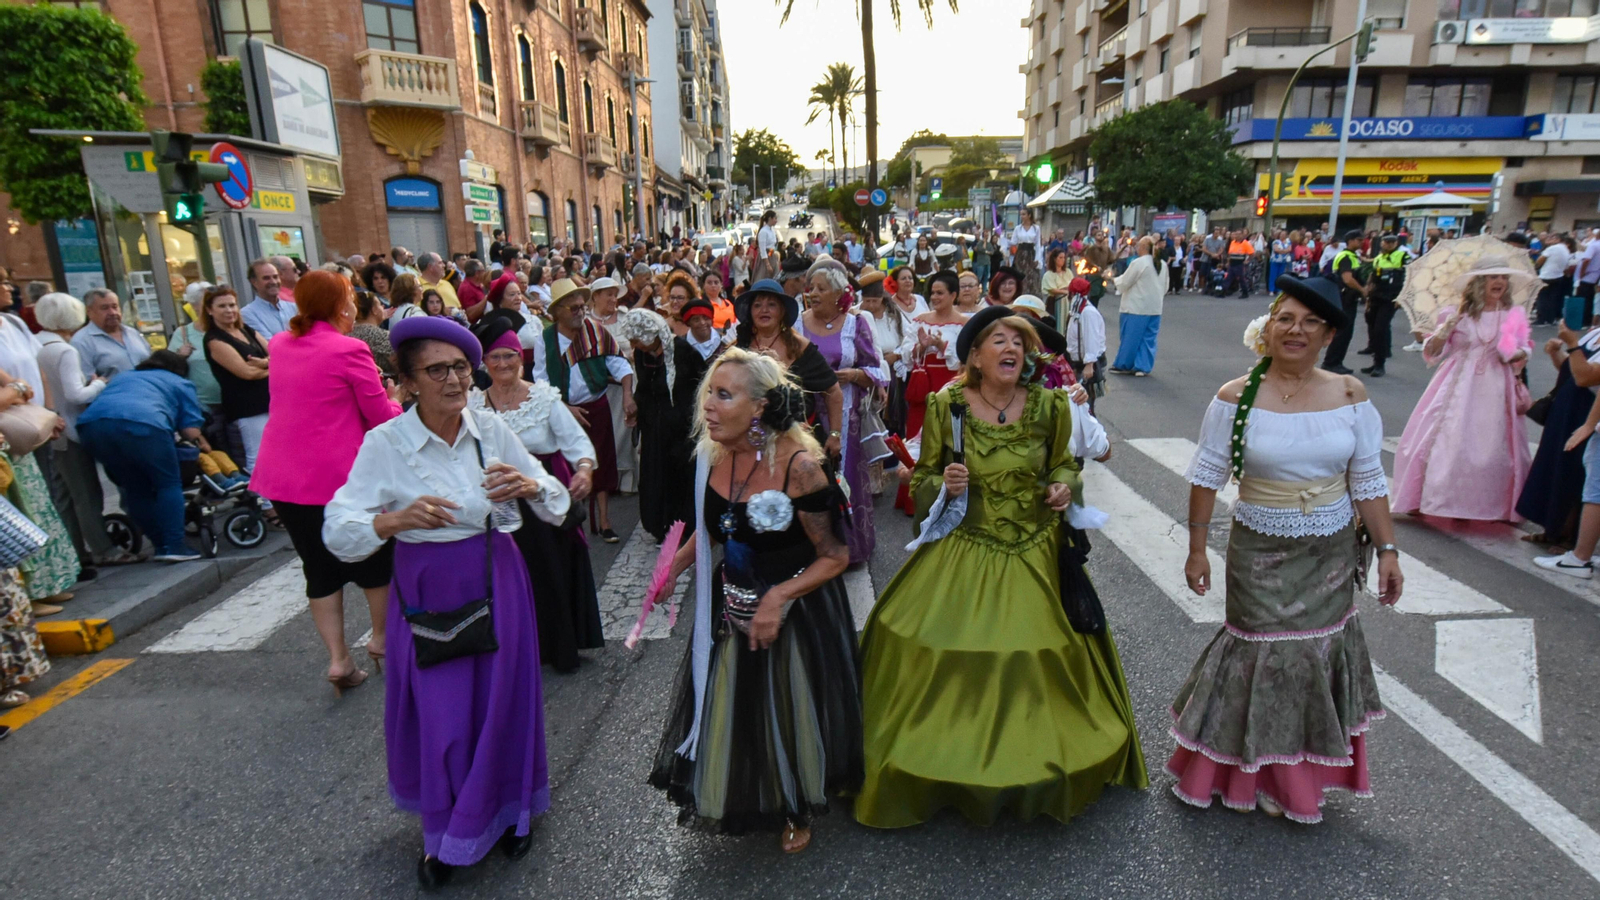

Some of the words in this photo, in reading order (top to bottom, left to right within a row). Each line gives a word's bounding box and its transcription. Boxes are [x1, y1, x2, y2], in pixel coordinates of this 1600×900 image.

[1348, 119, 1413, 136] OCASO
[1420, 124, 1474, 136] SEGUROS
[1379, 160, 1418, 171] Kodak
[1366, 175, 1389, 183] FOTO
[263, 194, 291, 208] ONCE
